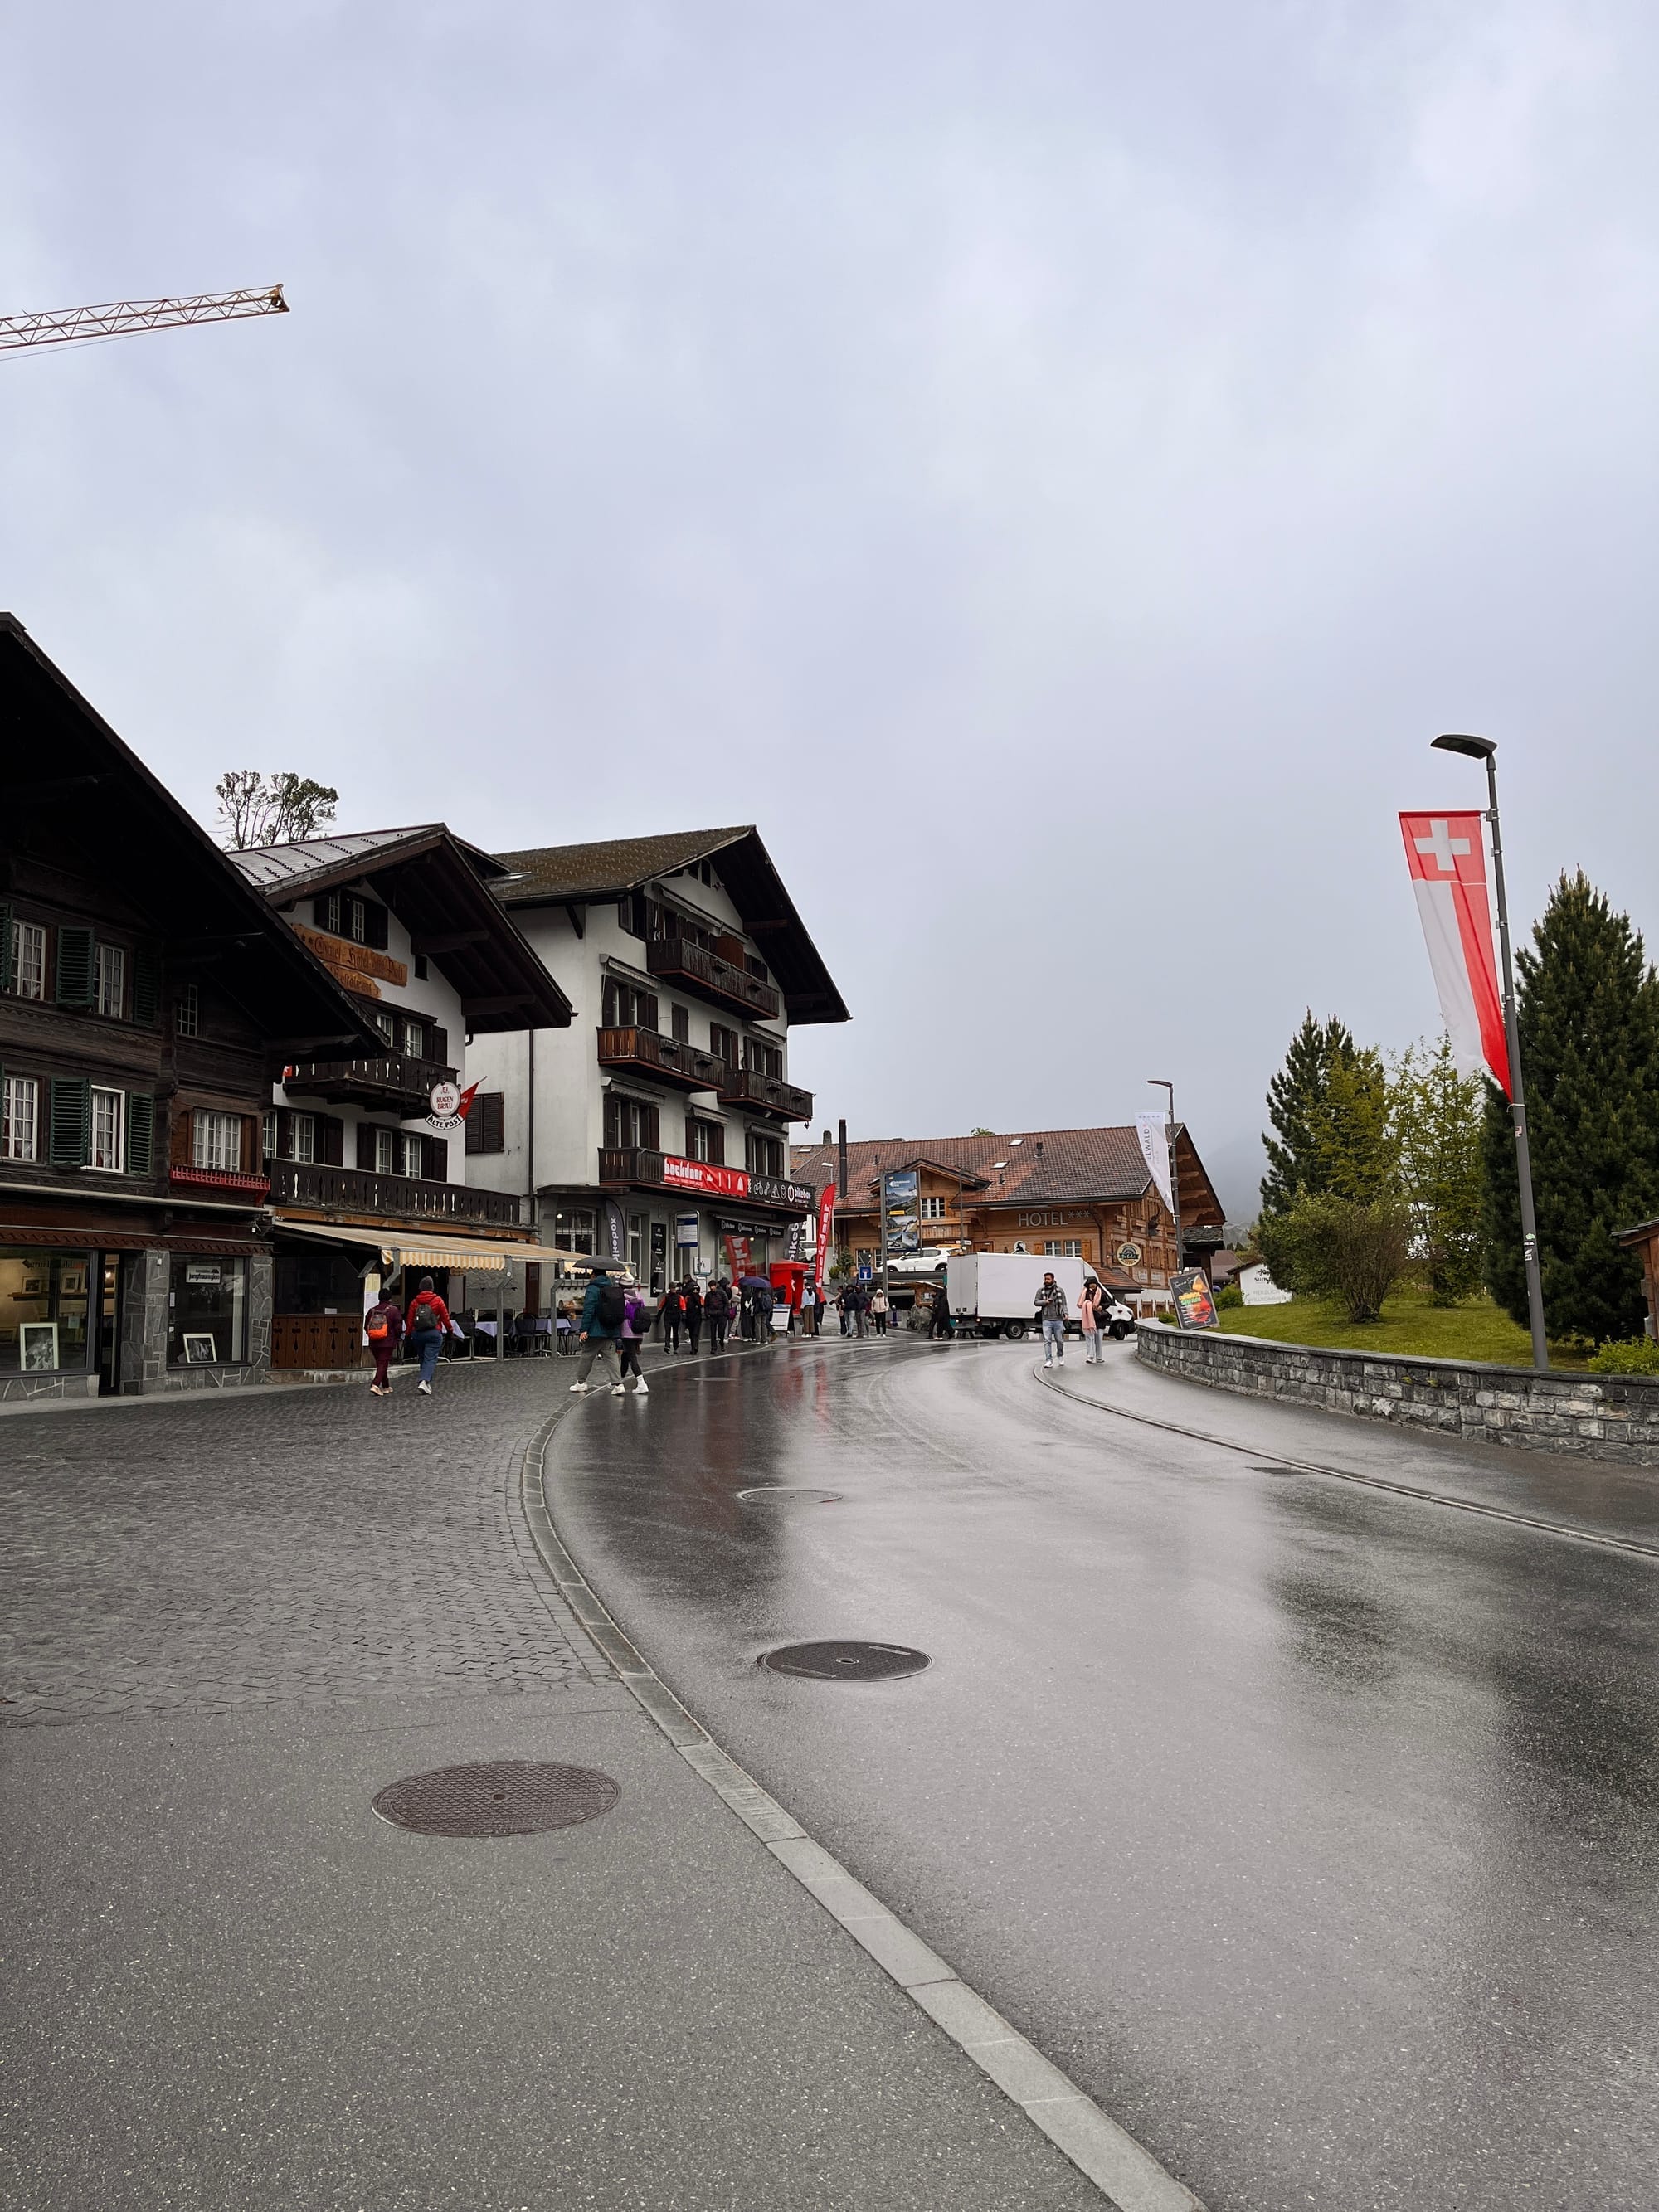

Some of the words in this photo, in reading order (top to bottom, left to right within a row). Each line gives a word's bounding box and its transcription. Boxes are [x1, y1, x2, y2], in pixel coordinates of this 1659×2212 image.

[427, 1116, 443, 1128] ALTE
[445, 1115, 462, 1128] POST
[1018, 1212, 1068, 1227] HOTEL
